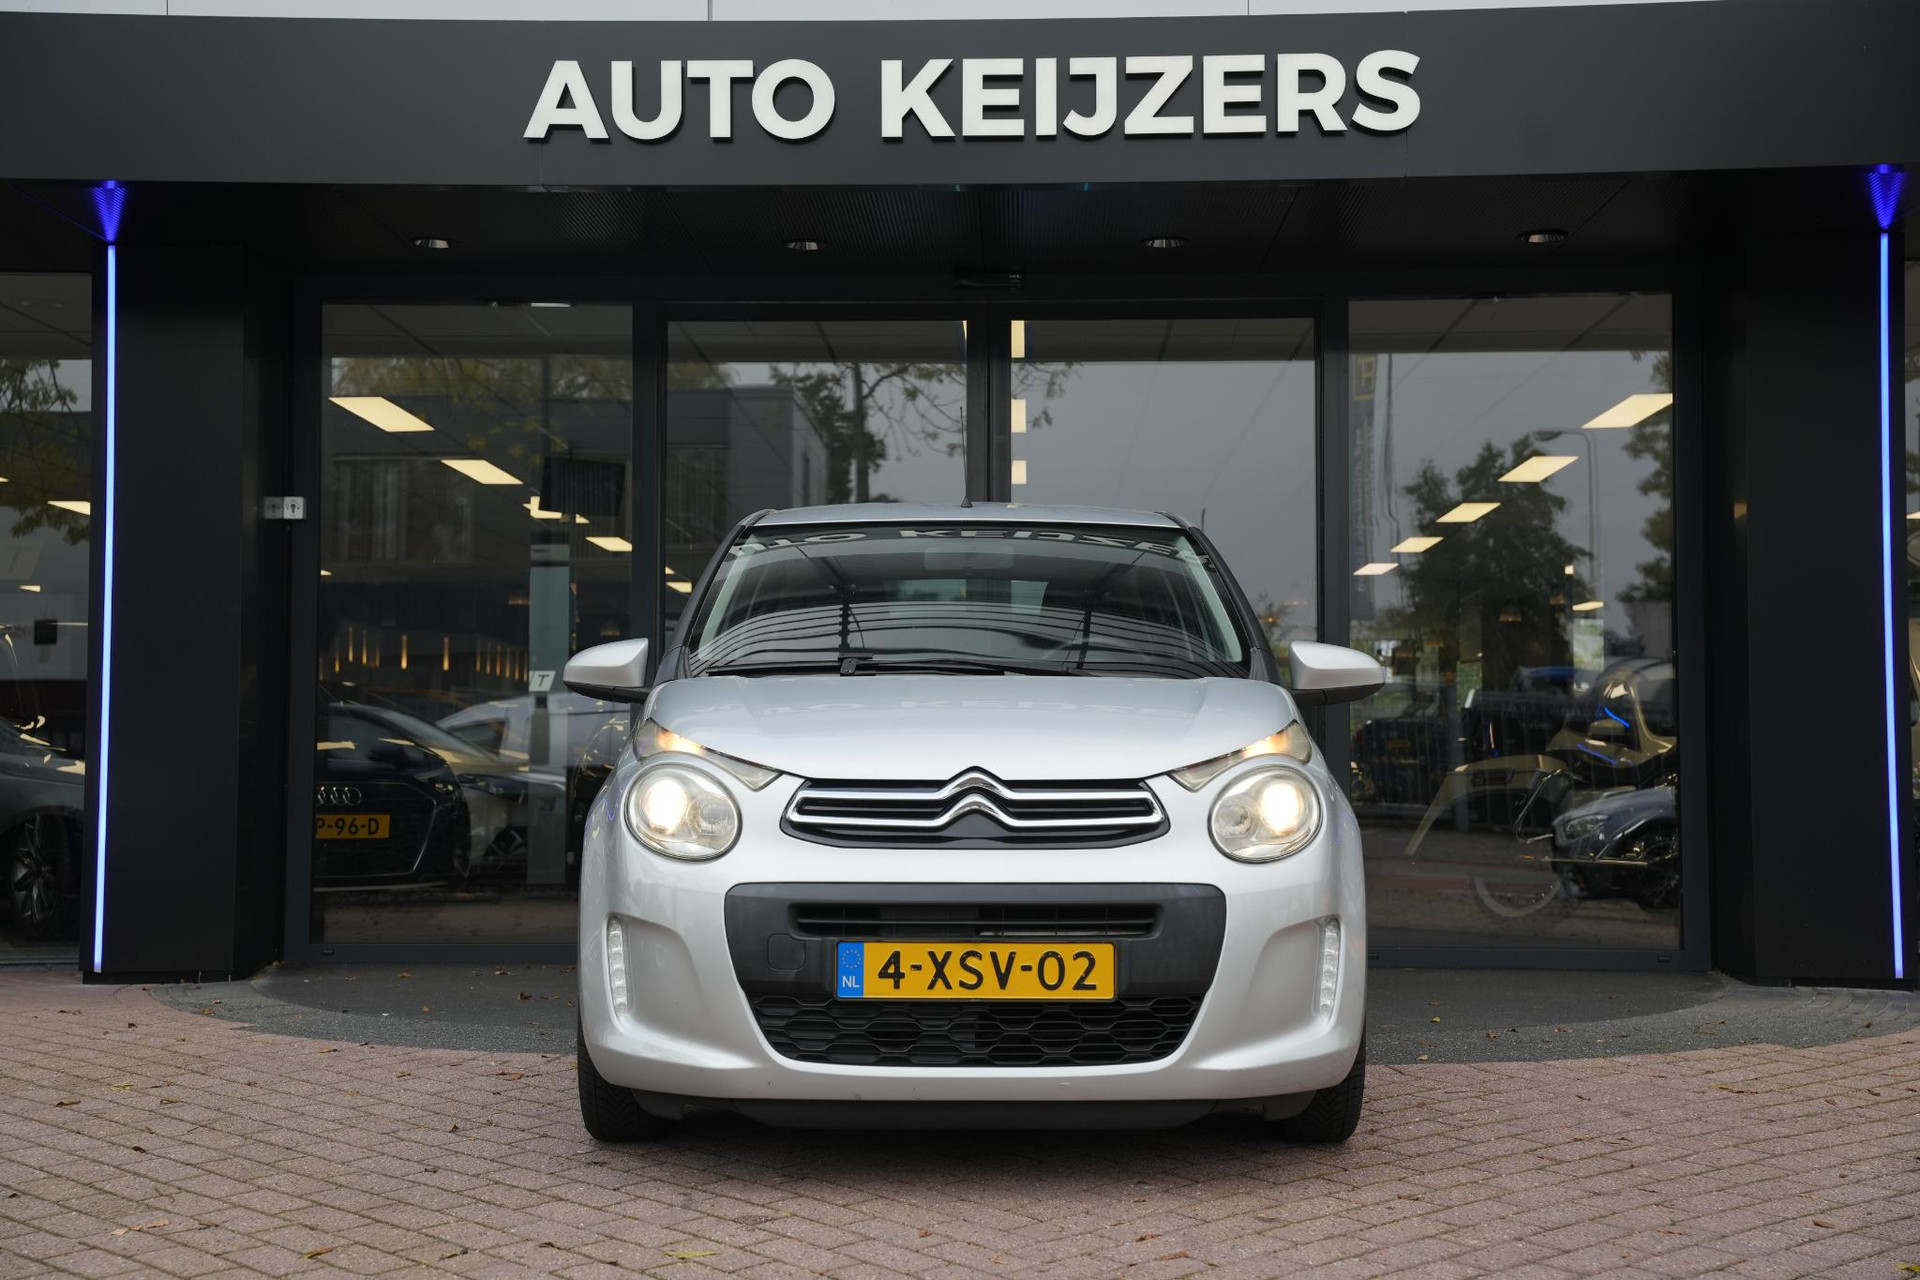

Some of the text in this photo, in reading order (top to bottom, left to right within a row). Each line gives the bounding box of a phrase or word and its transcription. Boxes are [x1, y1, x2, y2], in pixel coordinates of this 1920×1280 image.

[523, 49, 1422, 141] AUTO KEIJZERS
[842, 975, 860, 988] NL
[878, 950, 1097, 991] 4-XSV-02
